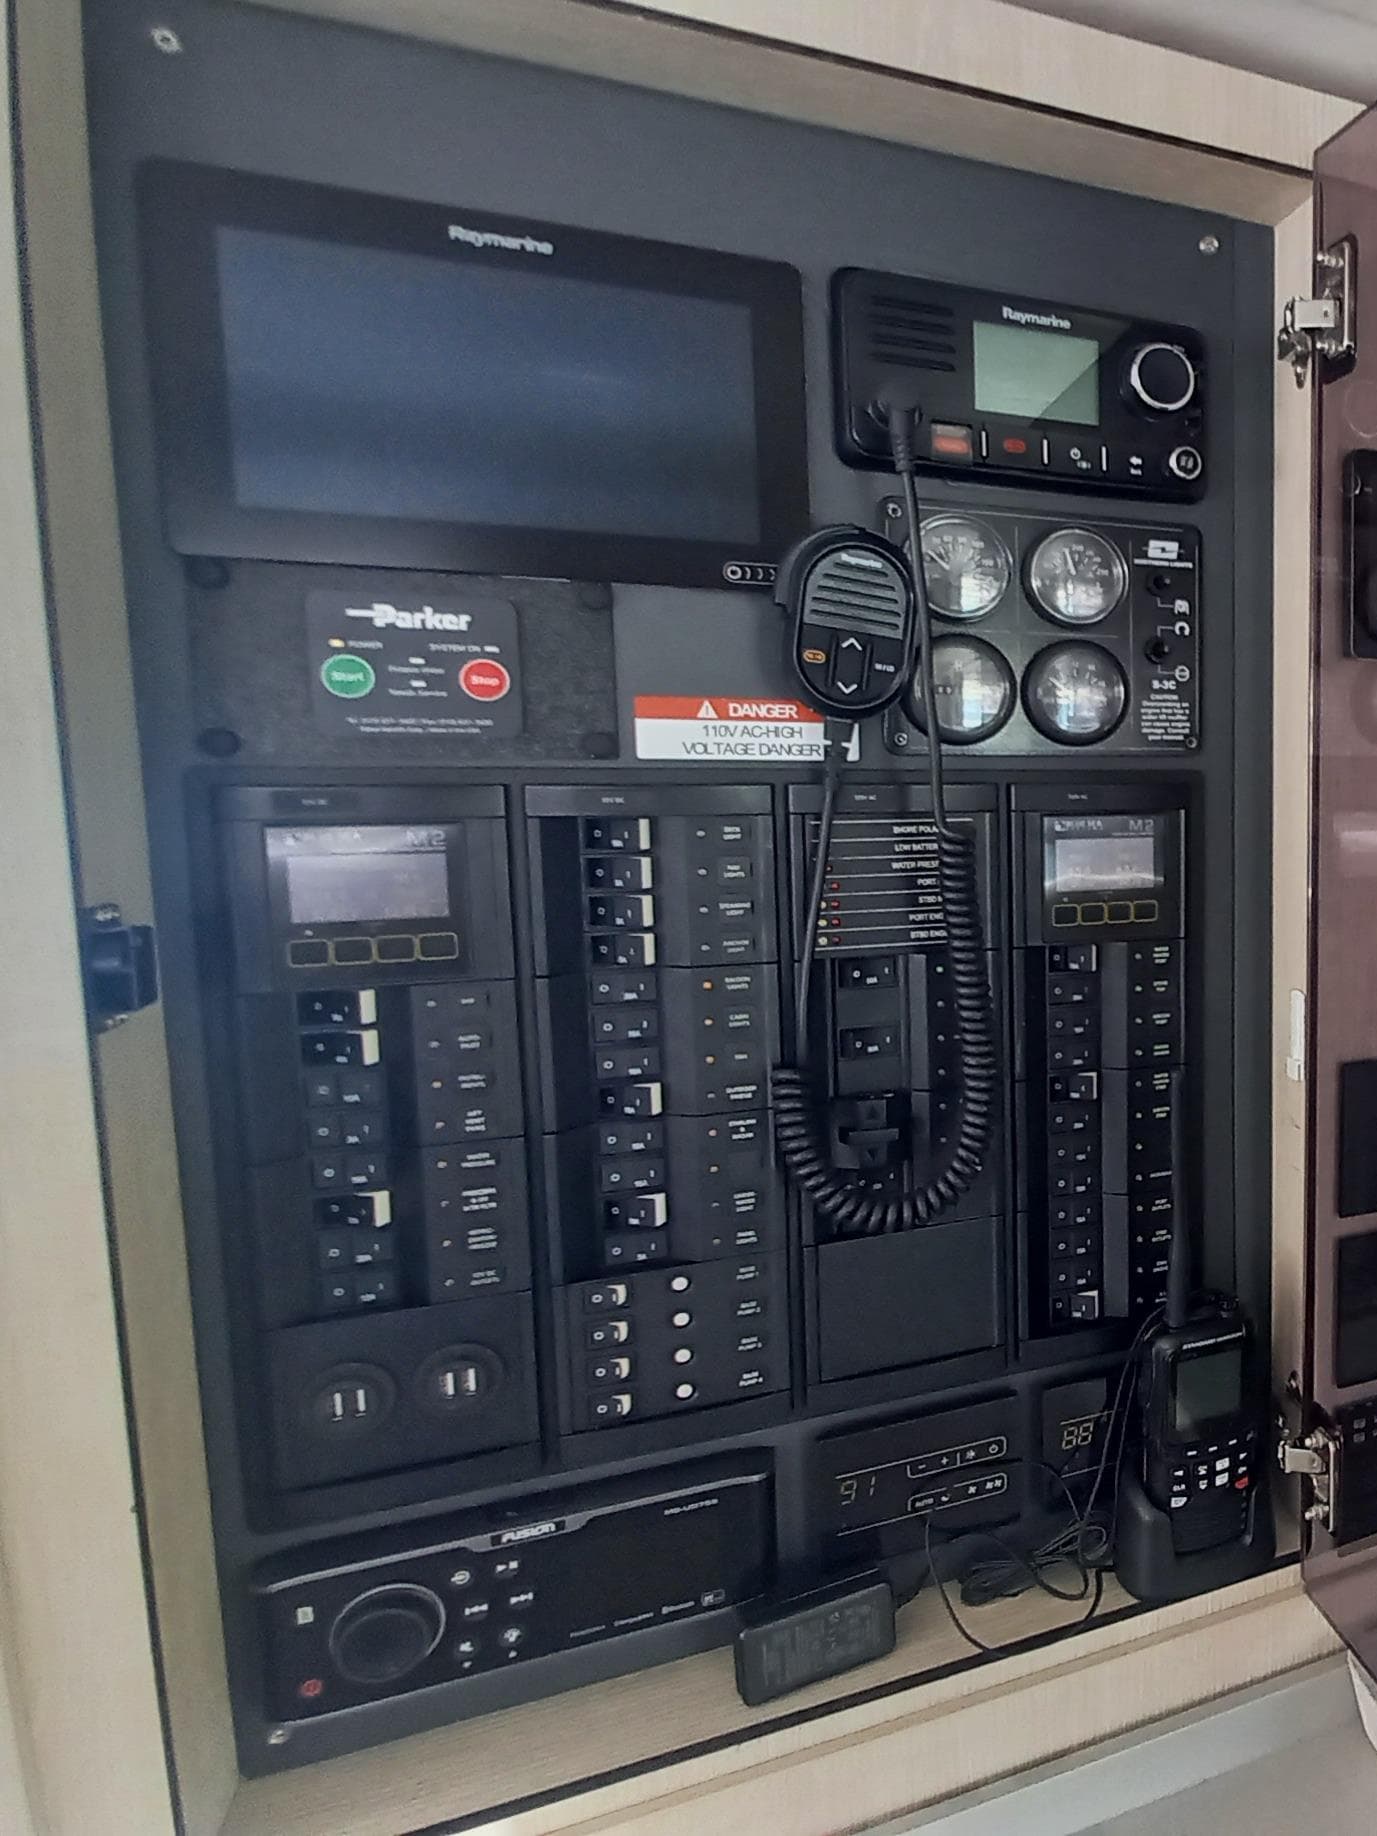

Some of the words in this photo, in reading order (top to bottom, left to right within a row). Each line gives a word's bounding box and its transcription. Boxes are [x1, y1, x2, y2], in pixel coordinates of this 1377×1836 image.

[448, 224, 555, 256] Raymarine
[1002, 305, 1071, 330] Raymarine
[371, 602, 473, 632] Parker
[330, 669, 366, 683] Start
[470, 674, 500, 688] Stop
[728, 703, 798, 719] DANGER
[702, 725, 738, 738] 110V
[682, 741, 756, 757] VOLTAGE
[758, 743, 821, 758] DANGER
[912, 842, 939, 851] BATTER
[501, 1522, 556, 1544] FUSION
